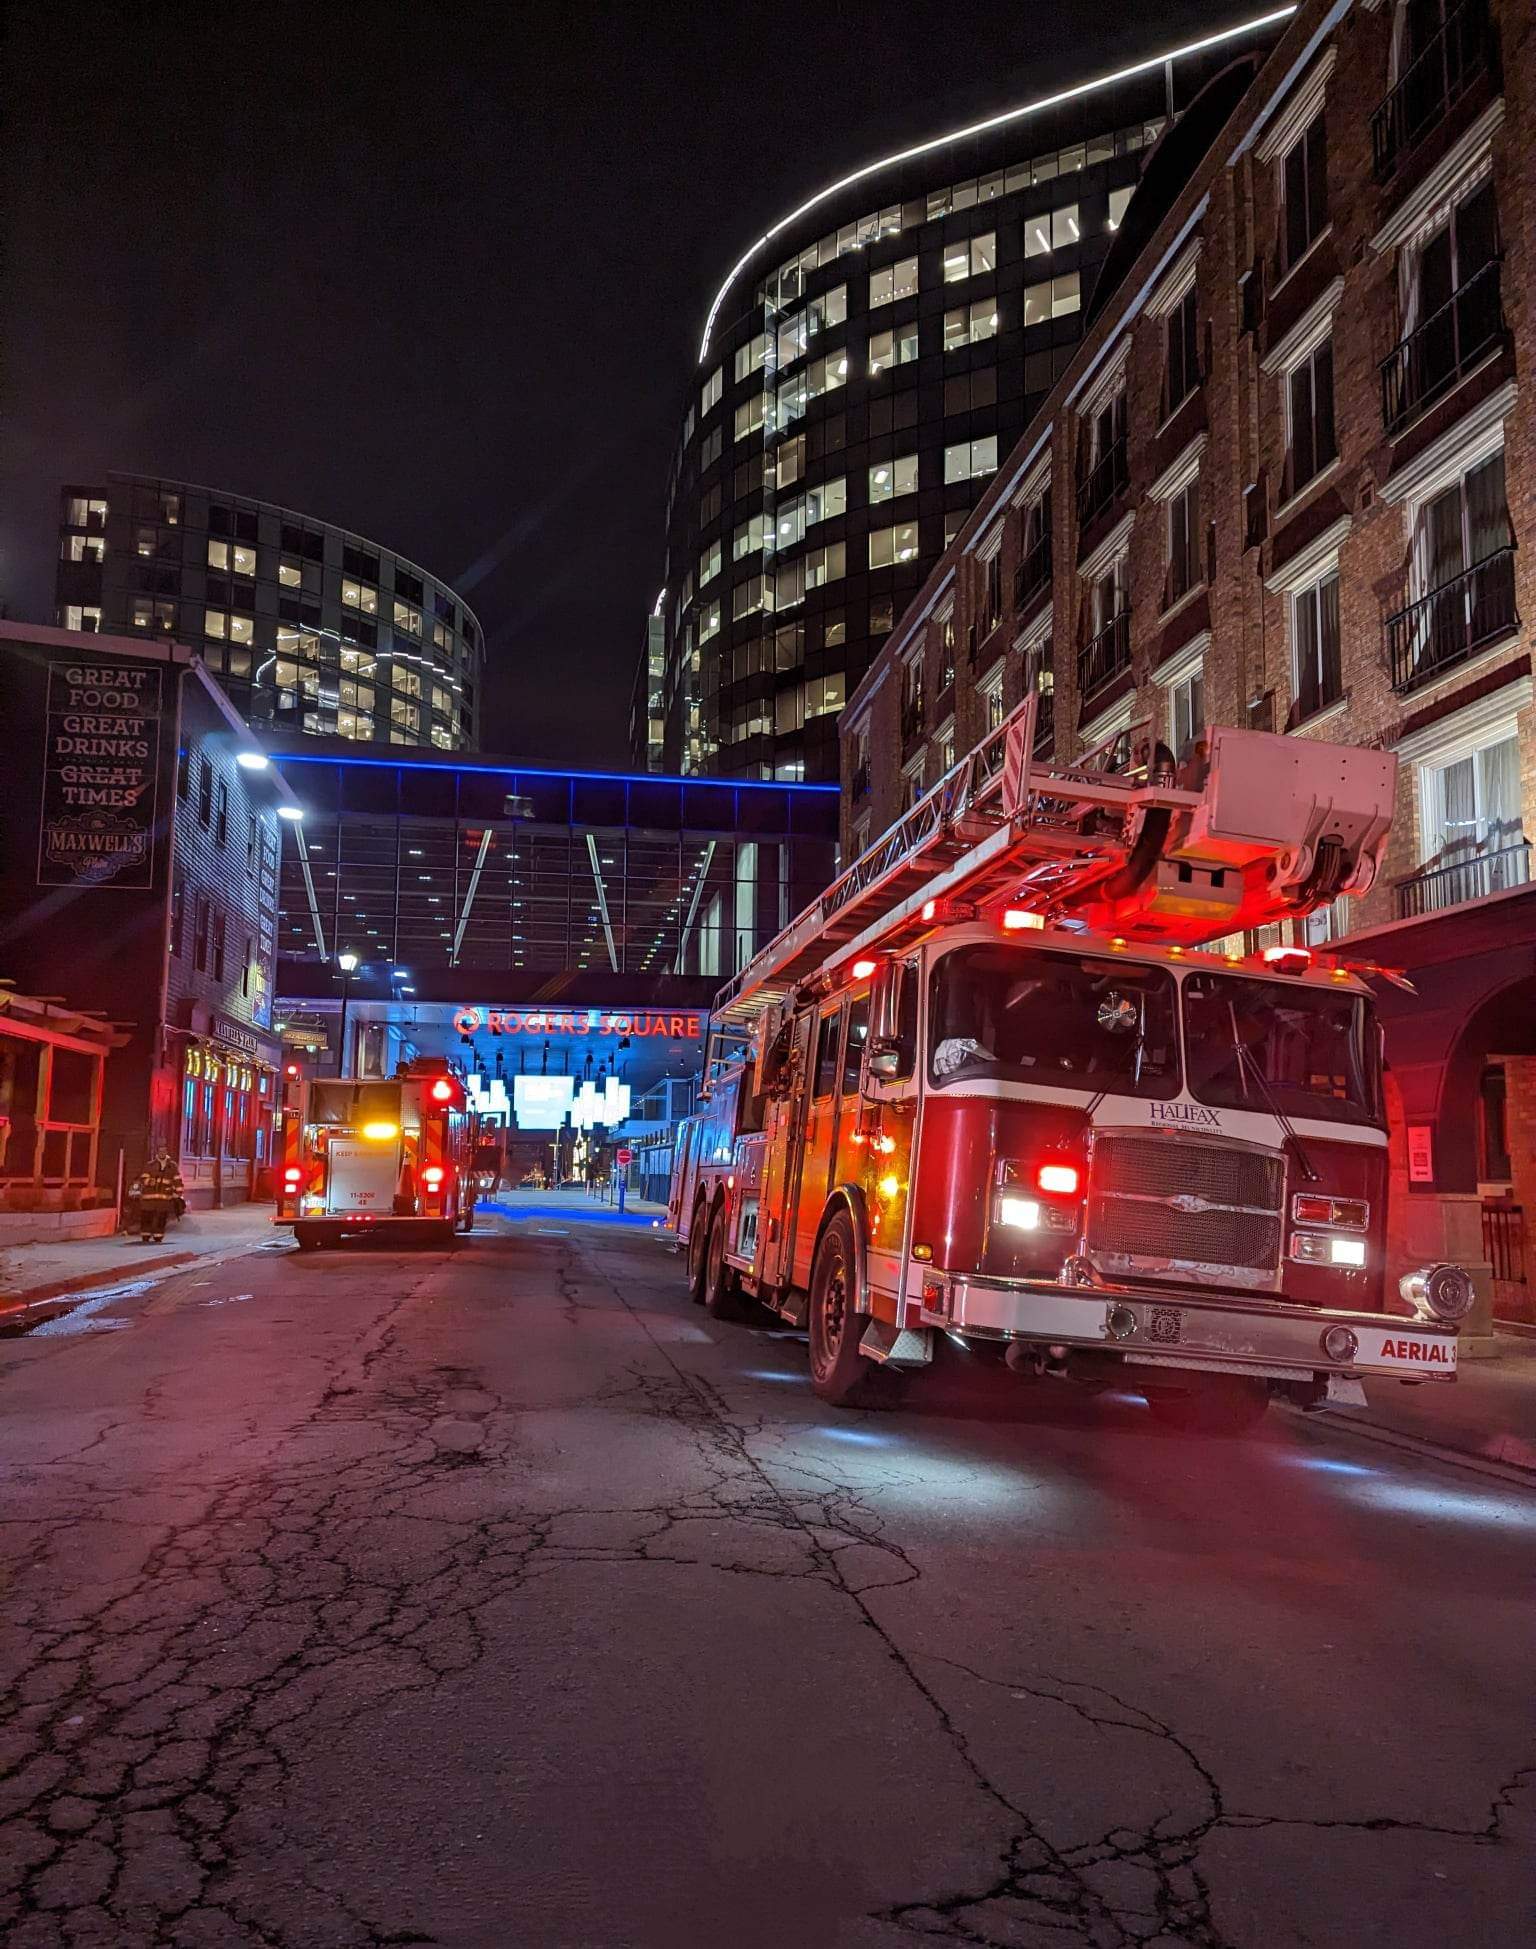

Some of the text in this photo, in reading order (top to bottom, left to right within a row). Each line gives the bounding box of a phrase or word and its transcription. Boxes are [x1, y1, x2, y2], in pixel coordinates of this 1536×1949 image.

[65, 668, 147, 688] GREAT
[69, 689, 140, 709] FOOD
[63, 716, 145, 736] GREAT
[55, 736, 149, 758] DRINKS
[60, 765, 143, 785] GREAT
[62, 786, 138, 807] TIMES
[50, 831, 143, 854] MAXWELL'S
[488, 1012, 701, 1038] ROGERS SQUARE
[1150, 1102, 1222, 1126] HALIFAX
[1381, 1339, 1448, 1363] AERIAL
